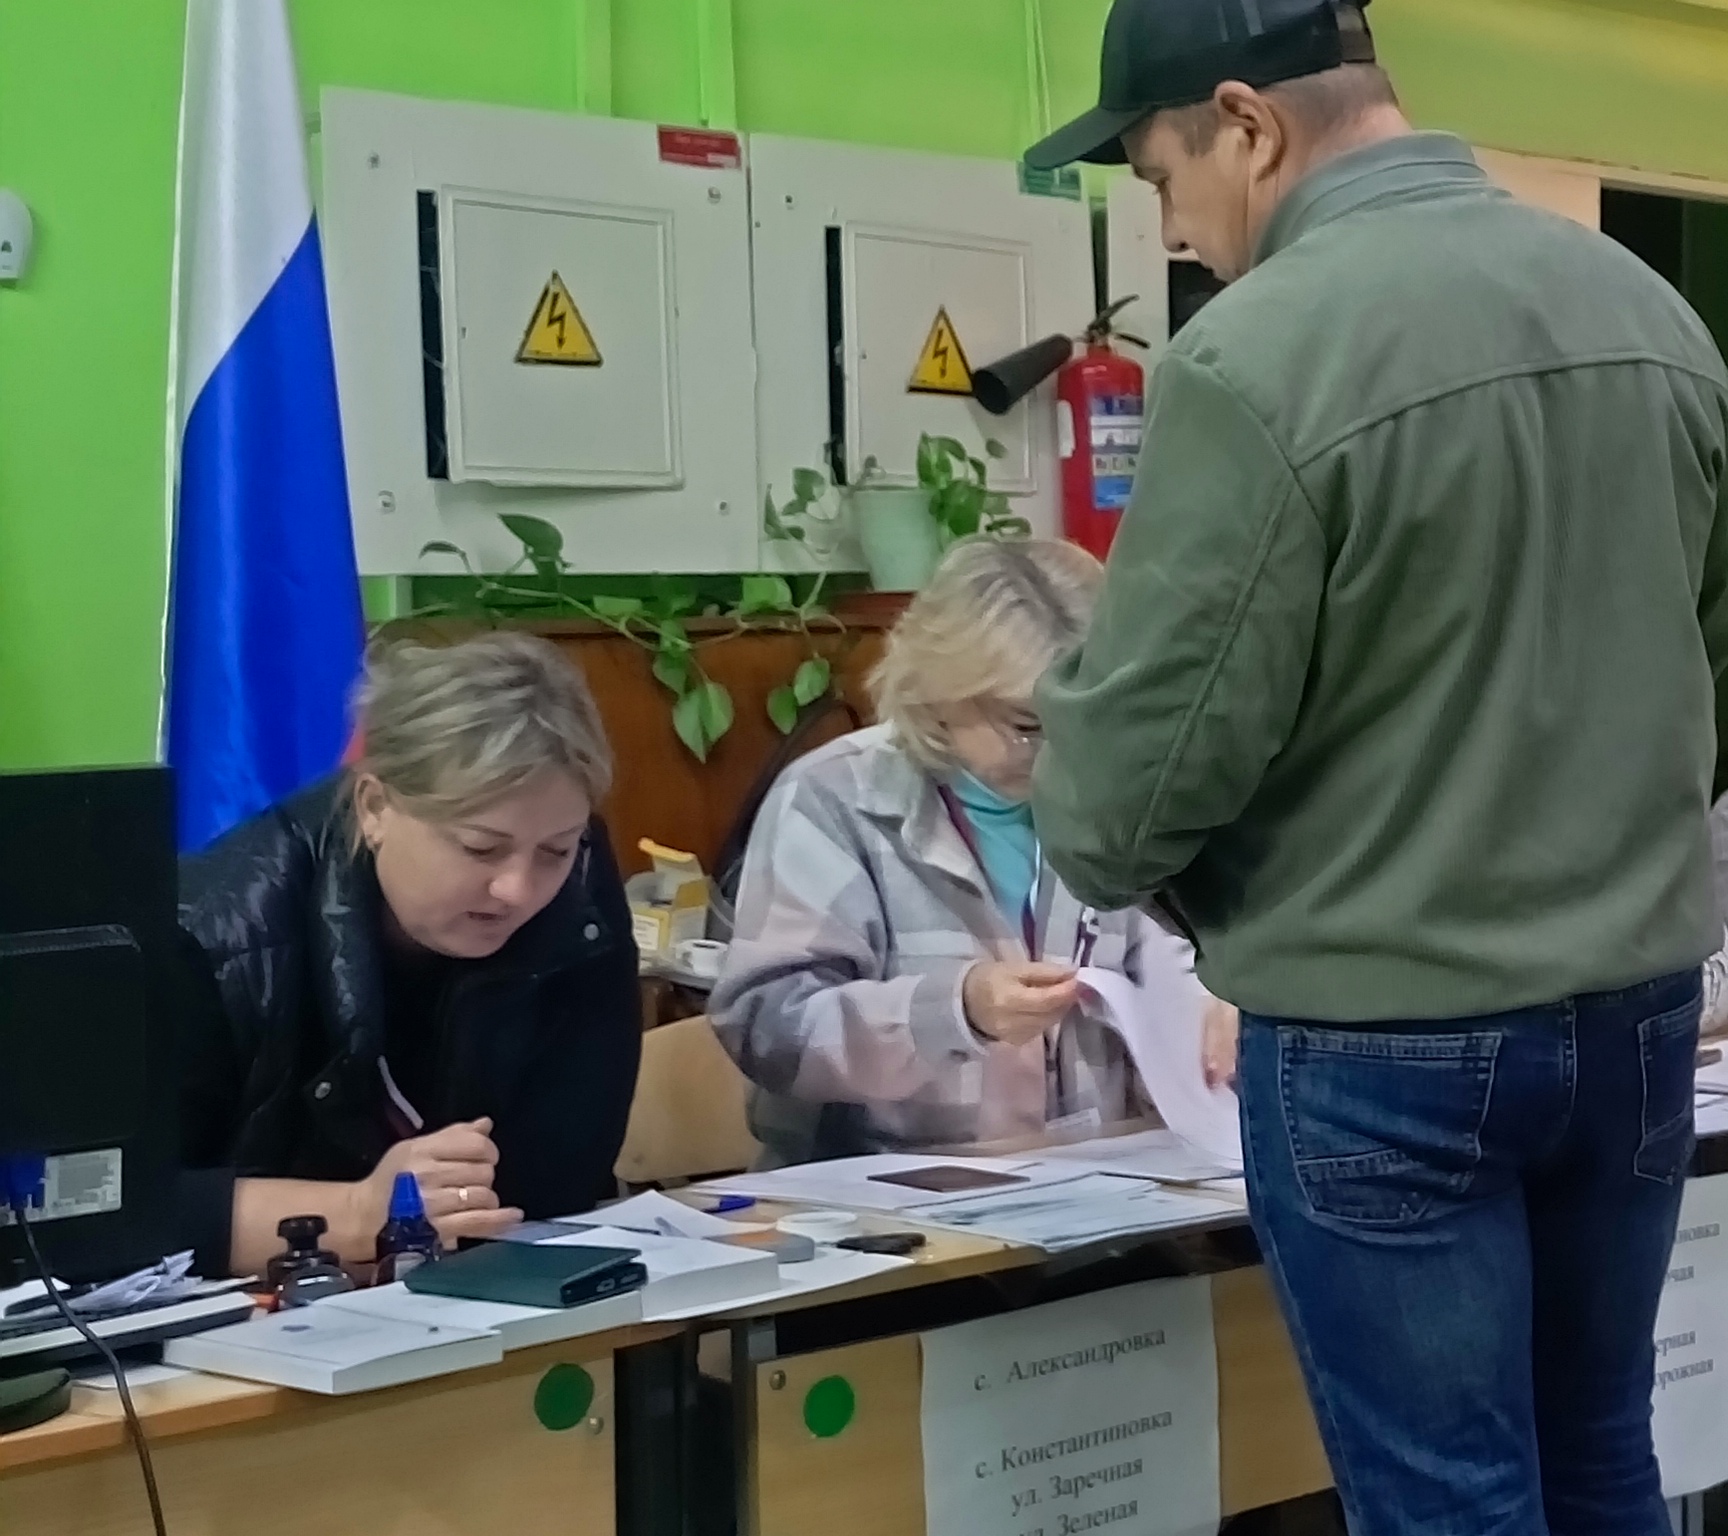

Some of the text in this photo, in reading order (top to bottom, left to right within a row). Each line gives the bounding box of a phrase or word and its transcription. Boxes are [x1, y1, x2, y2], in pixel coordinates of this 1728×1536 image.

[973, 1328, 1167, 1392] с. Александровка
[975, 1410, 1173, 1479] с. Константиновка
[1011, 1458, 1144, 1517] ул. Заречная
